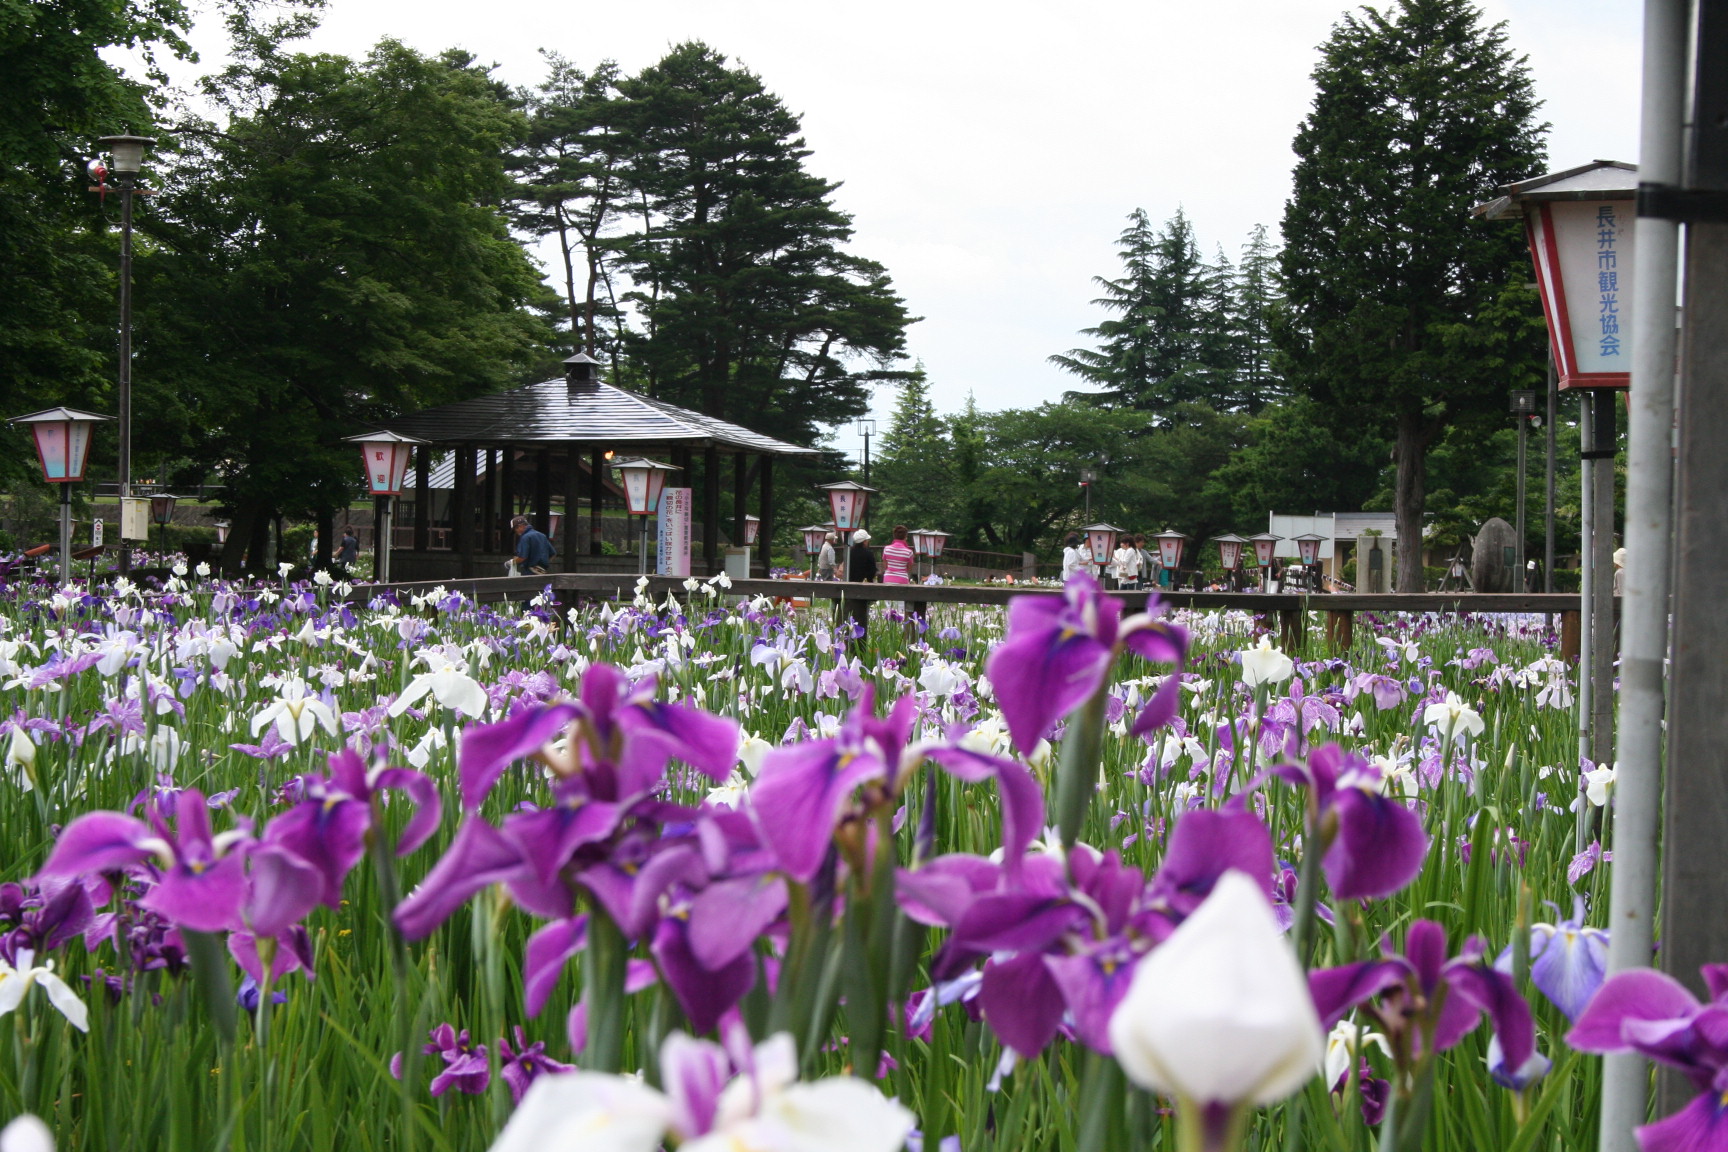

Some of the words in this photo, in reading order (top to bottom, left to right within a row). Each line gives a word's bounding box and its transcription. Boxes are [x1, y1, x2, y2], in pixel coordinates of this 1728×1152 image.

[1596, 206, 1620, 357] 長井市観光協会
[675, 489, 683, 514] 花の長井に
